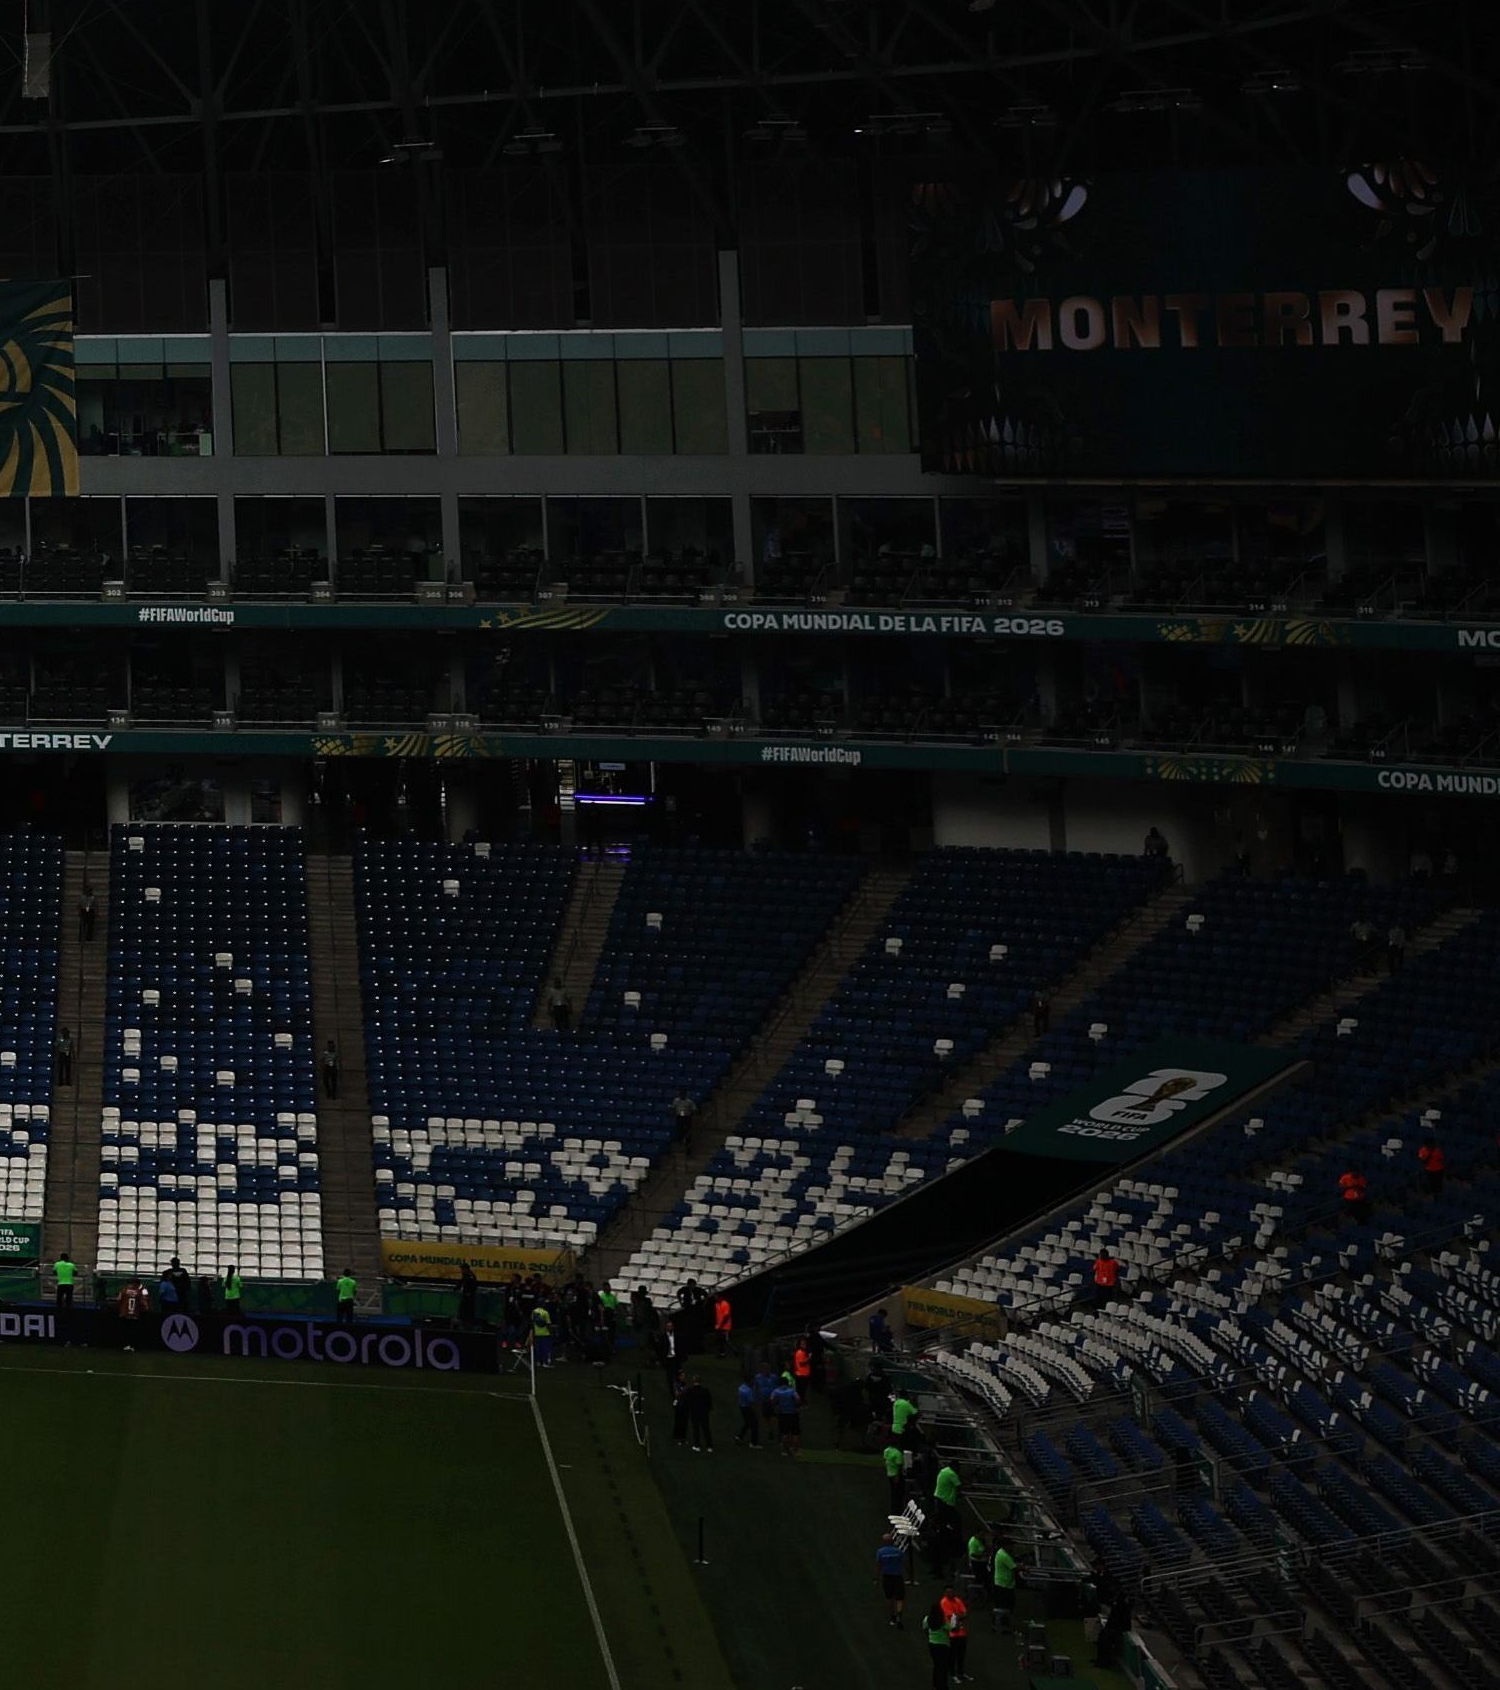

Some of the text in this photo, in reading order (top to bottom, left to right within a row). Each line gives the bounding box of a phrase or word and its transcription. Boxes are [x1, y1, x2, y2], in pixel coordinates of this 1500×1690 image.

[990, 287, 1473, 351] MONTERREY
[139, 608, 234, 624] #FIFAWorldCup
[725, 614, 1064, 635] COPA MUNDIAL DE LA FIFA 2026
[762, 747, 860, 765] #FIFAWorldCup
[1378, 773, 1432, 790] COPA
[1071, 1118, 1122, 1131] WORLD
[1111, 1111, 1148, 1121] FIFA
[1056, 1124, 1141, 1141] 2026
[13, 1236, 30, 1244] CUP
[223, 1323, 459, 1371] motorola
